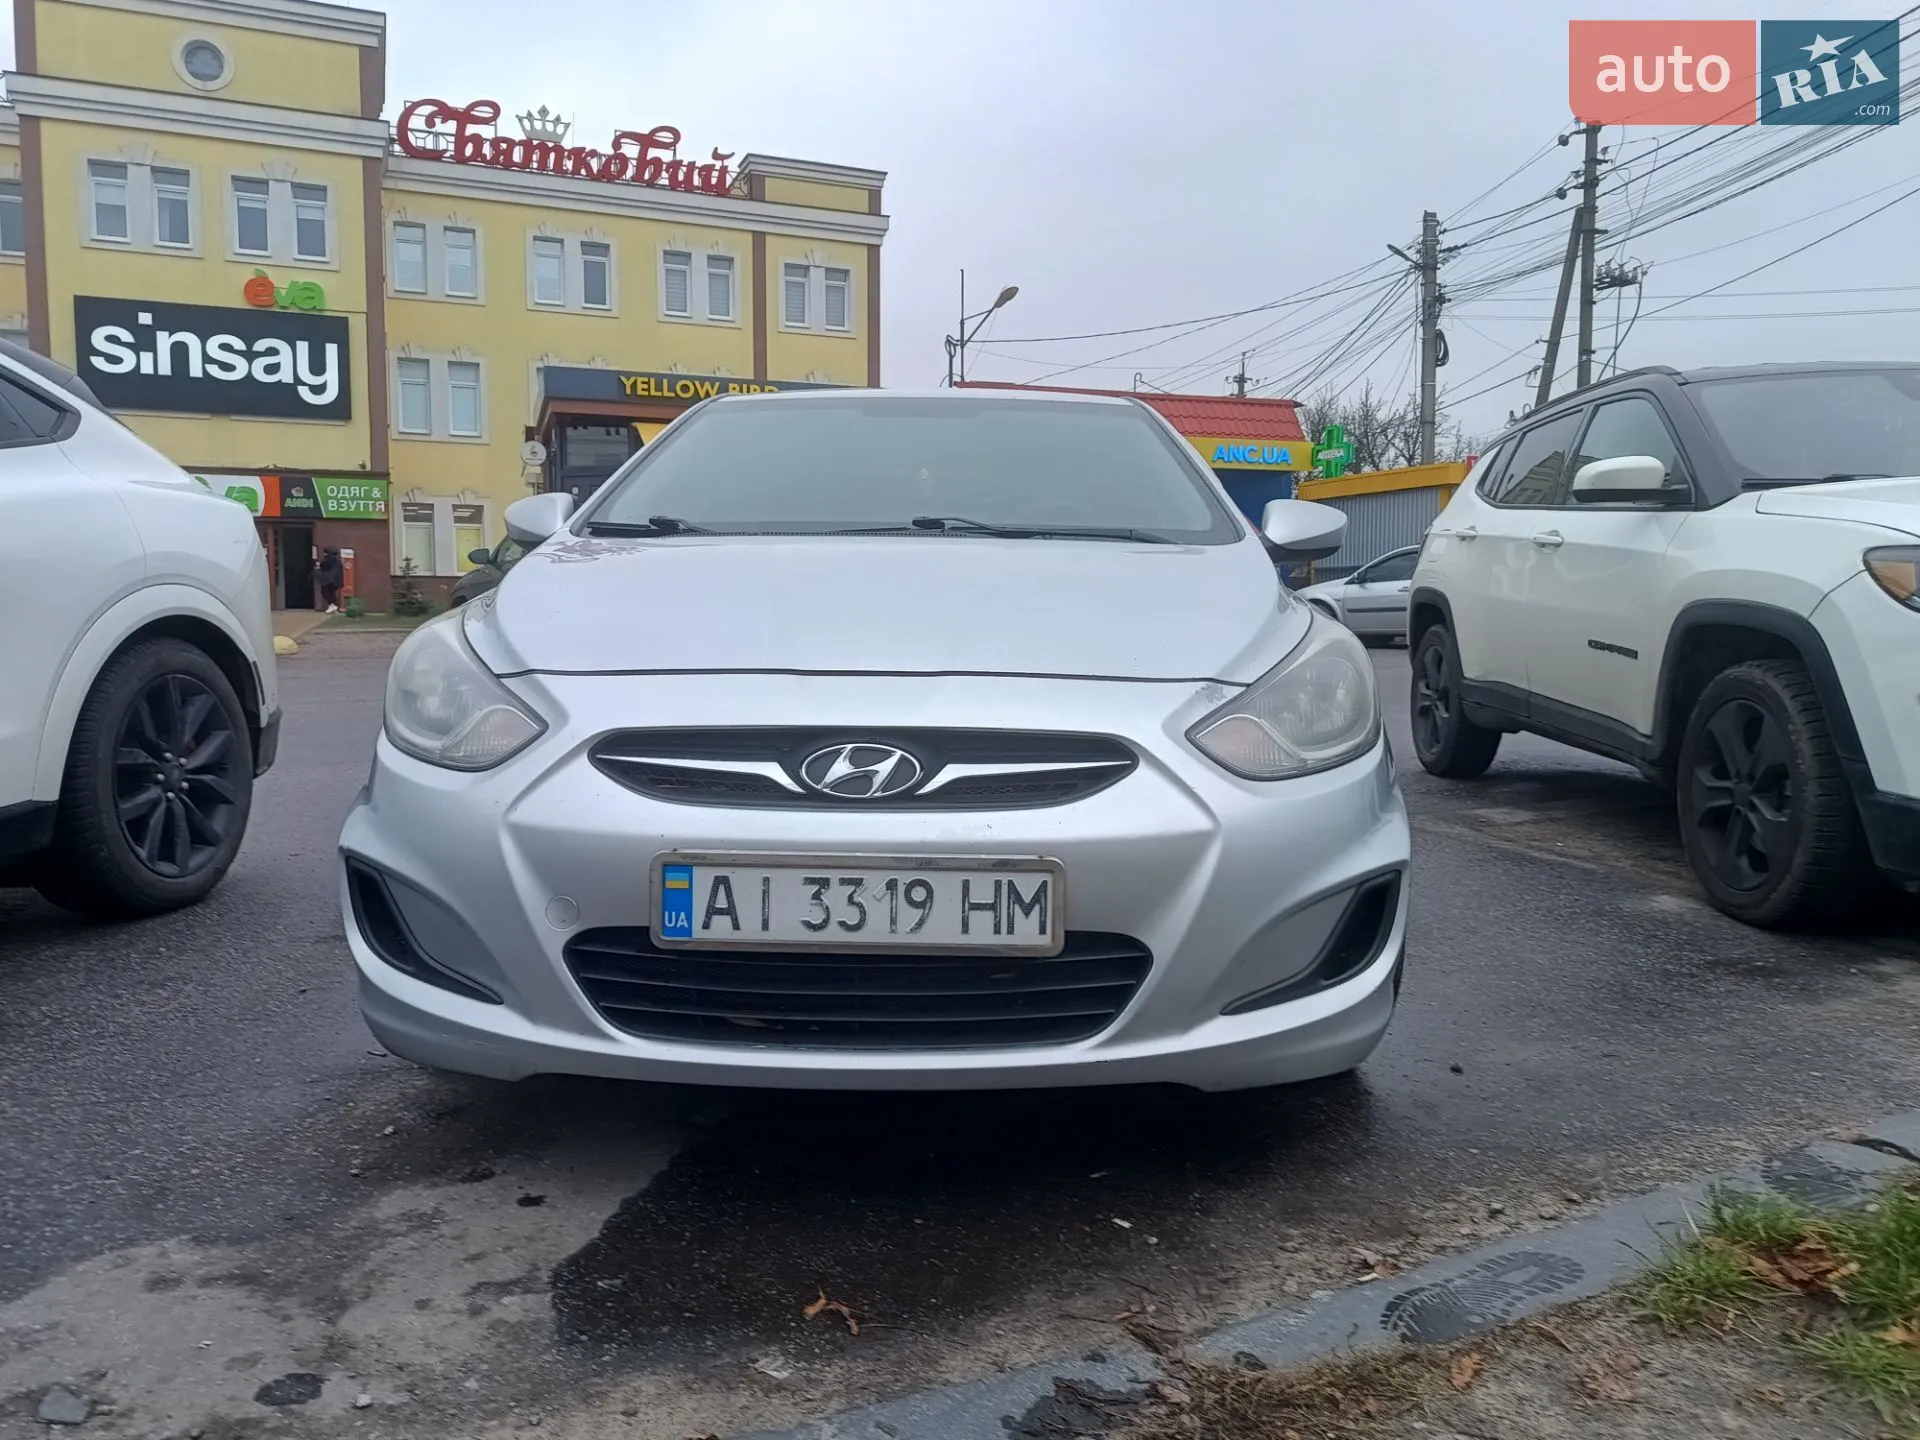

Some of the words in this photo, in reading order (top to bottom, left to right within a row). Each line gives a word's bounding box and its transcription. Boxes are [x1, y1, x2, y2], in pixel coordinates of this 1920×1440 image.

[89, 311, 340, 406] sinsay
[619, 375, 720, 399] YELLOW
[1214, 445, 1292, 465] ANC.UA
[327, 485, 370, 499] ОДЯГ
[371, 487, 382, 499] &
[328, 499, 385, 512] ВЗУТТЯ
[702, 875, 770, 932] AI
[800, 876, 935, 935] 3319
[961, 878, 1049, 936] HM
[664, 911, 689, 930] UA
